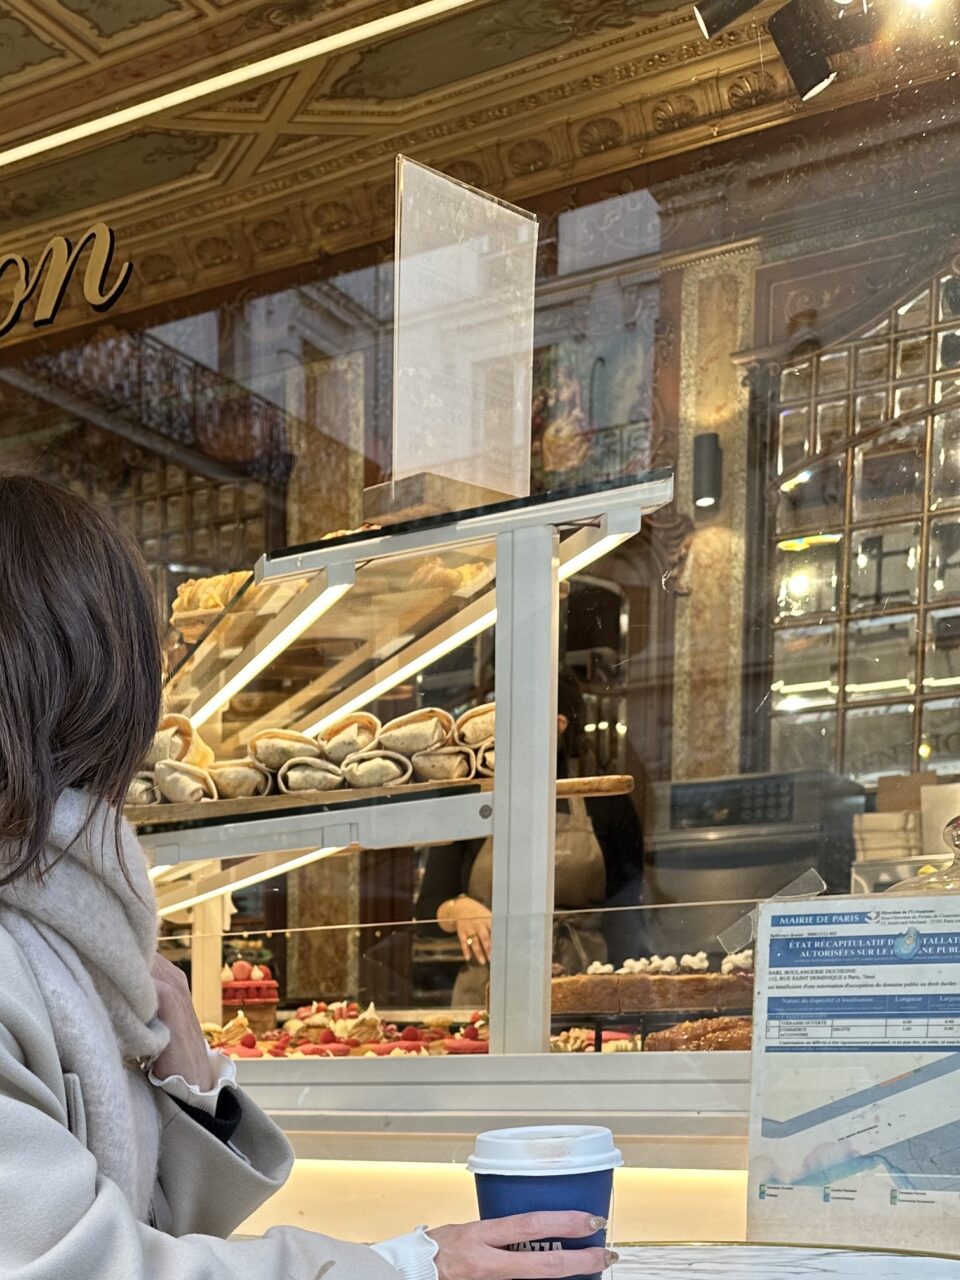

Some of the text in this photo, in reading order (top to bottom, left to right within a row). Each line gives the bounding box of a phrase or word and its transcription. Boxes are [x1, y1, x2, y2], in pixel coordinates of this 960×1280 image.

[779, 914, 860, 925] MAIRIE DE PARIS
[814, 938, 885, 948] RÉCAPITULATIF
[800, 949, 855, 957] AUTORISÉES
